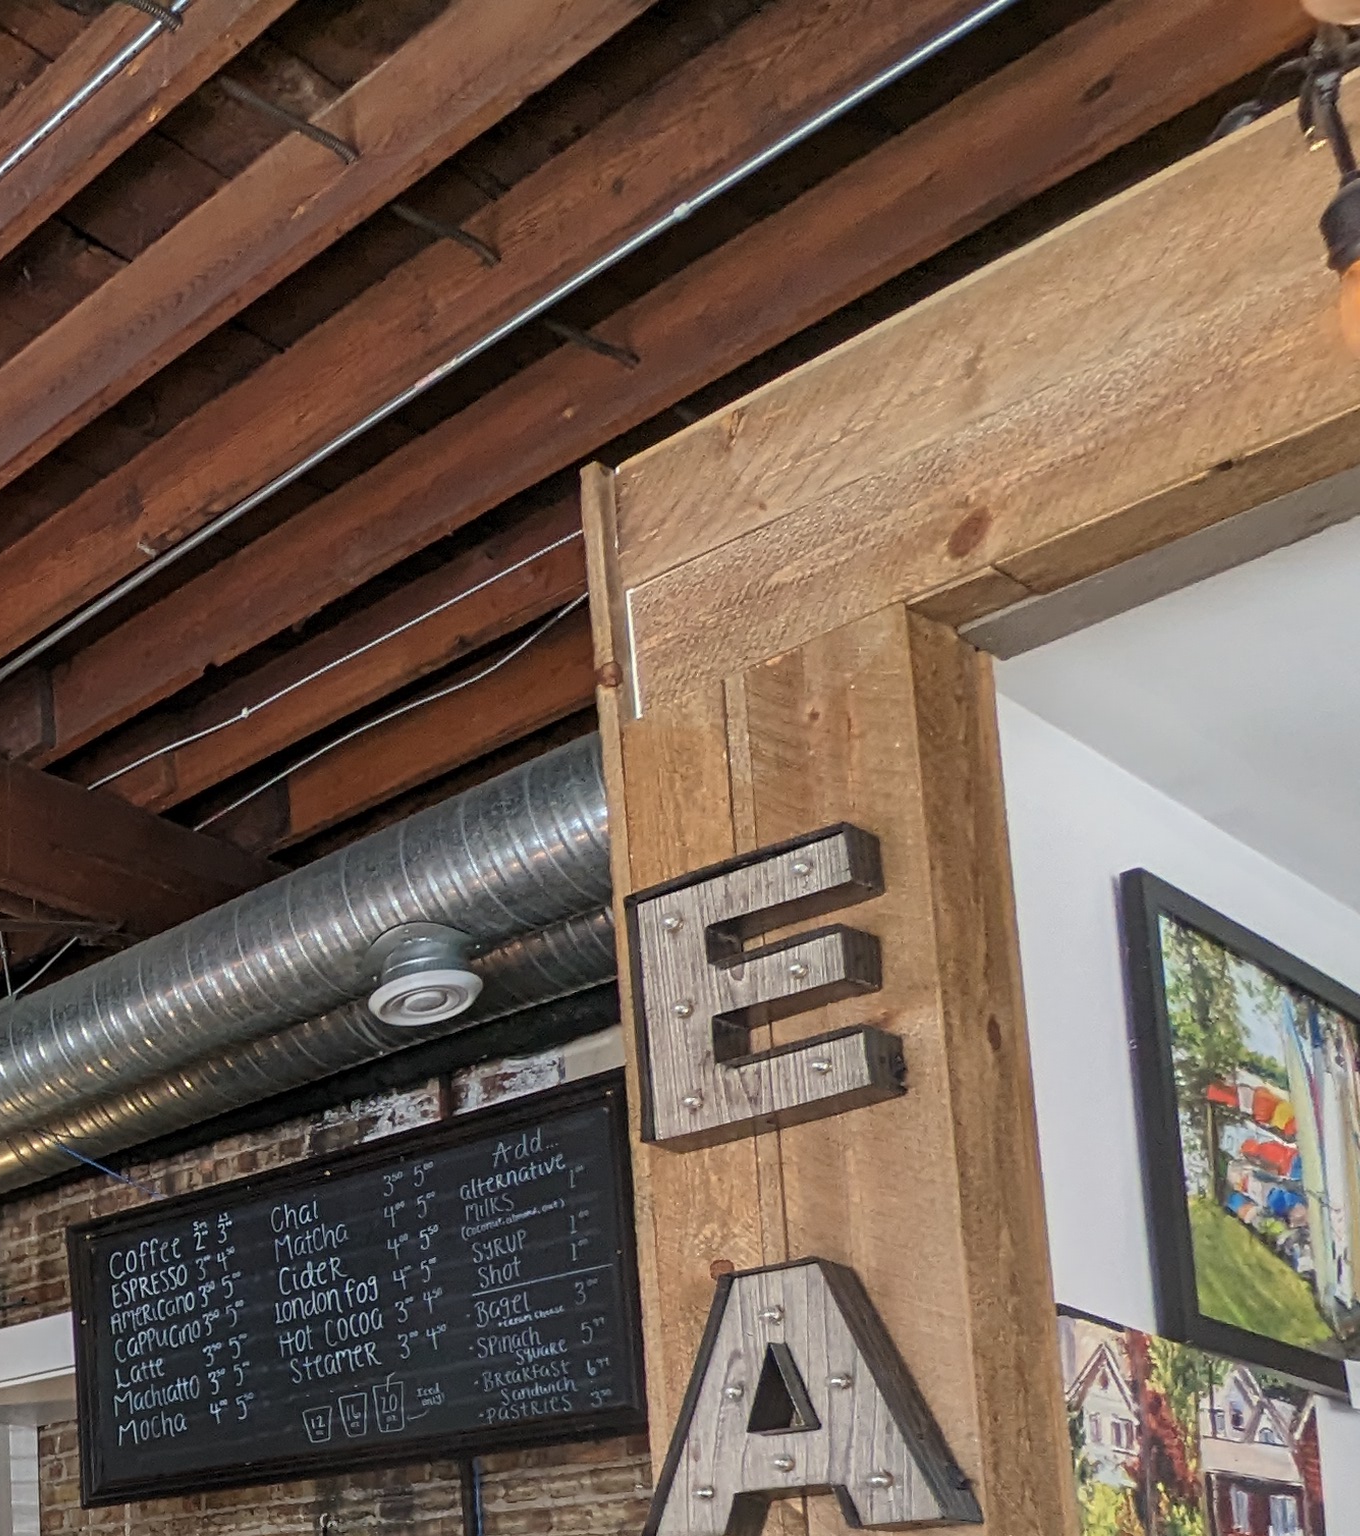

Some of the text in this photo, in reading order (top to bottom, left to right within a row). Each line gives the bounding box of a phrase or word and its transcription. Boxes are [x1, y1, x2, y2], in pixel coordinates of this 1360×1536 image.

[271, 1194, 319, 1233] Chai
[109, 1238, 181, 1280] Coffee
[274, 1223, 349, 1263] Matcha
[111, 1264, 188, 1309] ESPRESSO
[478, 1255, 522, 1288] Shot
[275, 1288, 343, 1324] London
[474, 1291, 530, 1328] Bagel
[279, 1325, 314, 1358] Hot
[325, 1307, 384, 1347] Cocoa
[476, 1326, 542, 1359] Spinach
[115, 1357, 166, 1389] Latte
[113, 1374, 200, 1418] Machiatto
[345, 1403, 361, 1422] 16
[381, 1393, 398, 1414] 20
[119, 1411, 188, 1446] Mocha
[311, 1414, 326, 1429] 12
